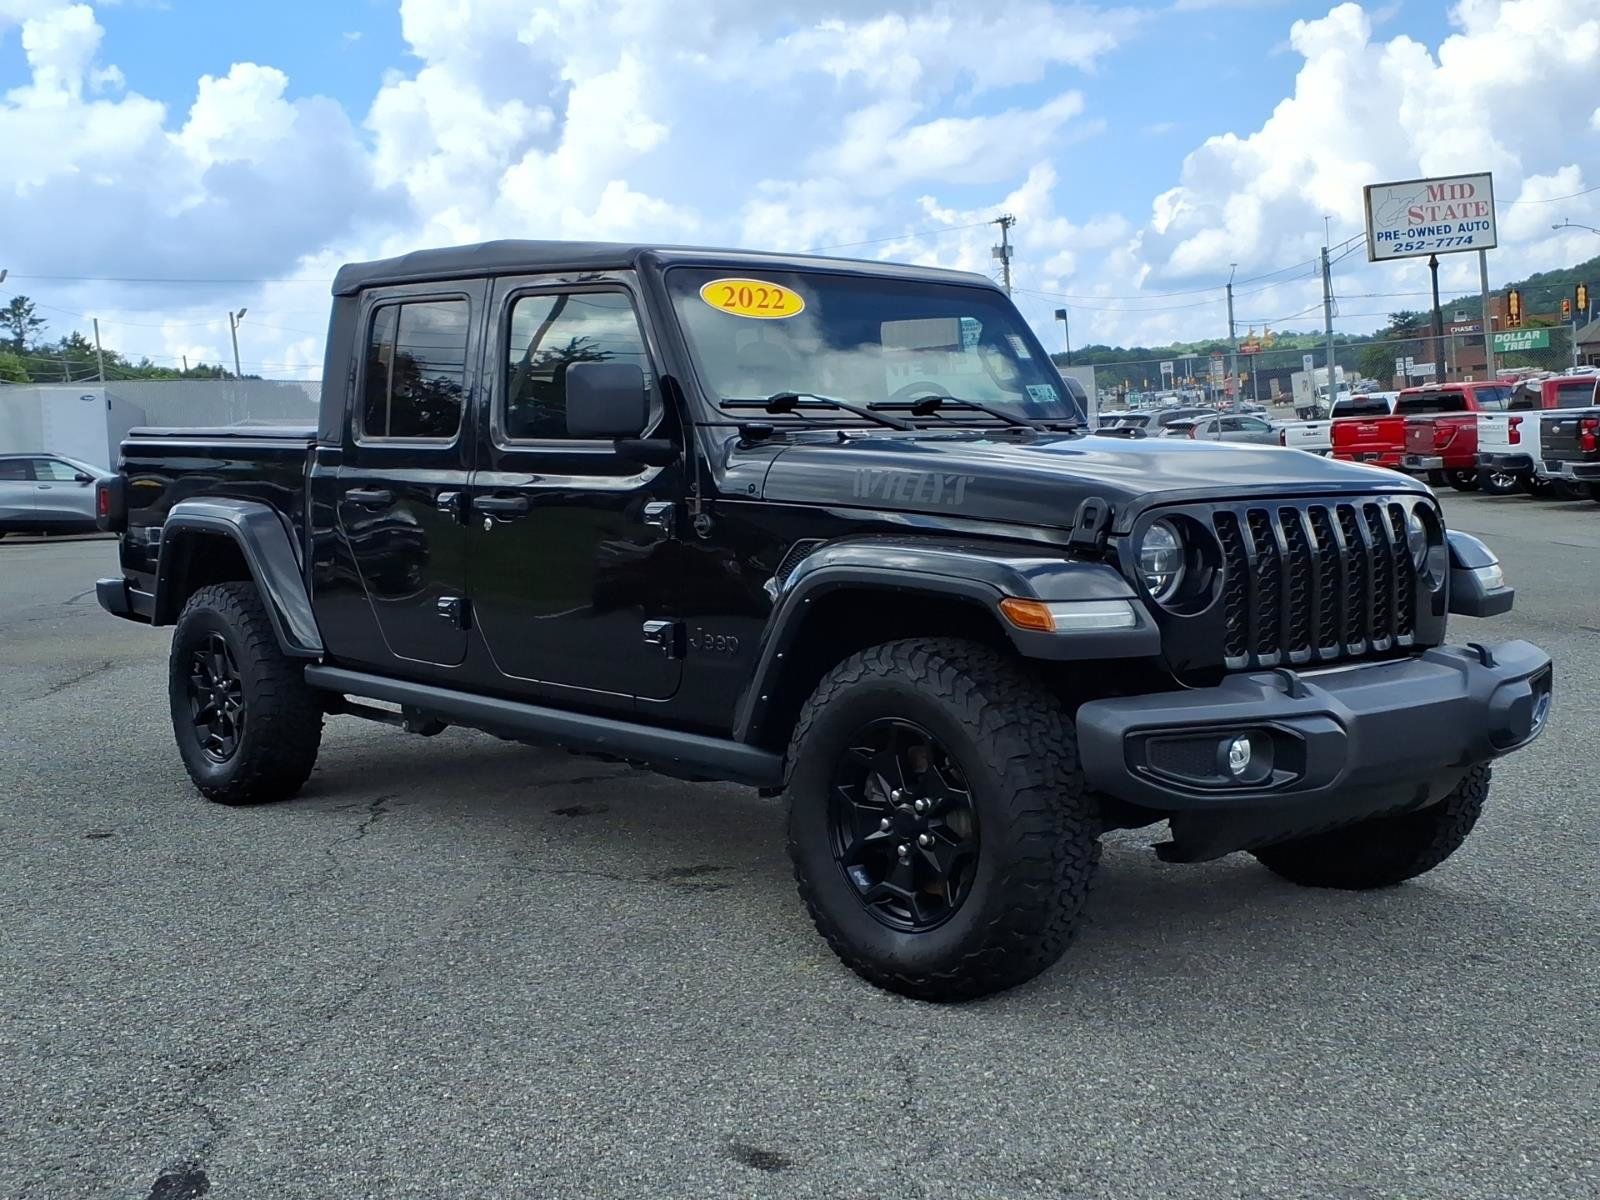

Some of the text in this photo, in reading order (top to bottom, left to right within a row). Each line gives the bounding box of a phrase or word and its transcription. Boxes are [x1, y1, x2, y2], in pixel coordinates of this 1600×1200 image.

[1426, 183, 1475, 203] MID
[1408, 201, 1489, 226] STATE
[1377, 220, 1490, 242] PRE-OWNED AUTO
[1393, 235, 1473, 253] 252-7774
[722, 286, 785, 309] 2022
[1450, 325, 1474, 333] CHASE
[1494, 330, 1540, 343] DOLLAR
[1503, 340, 1532, 352] TREE
